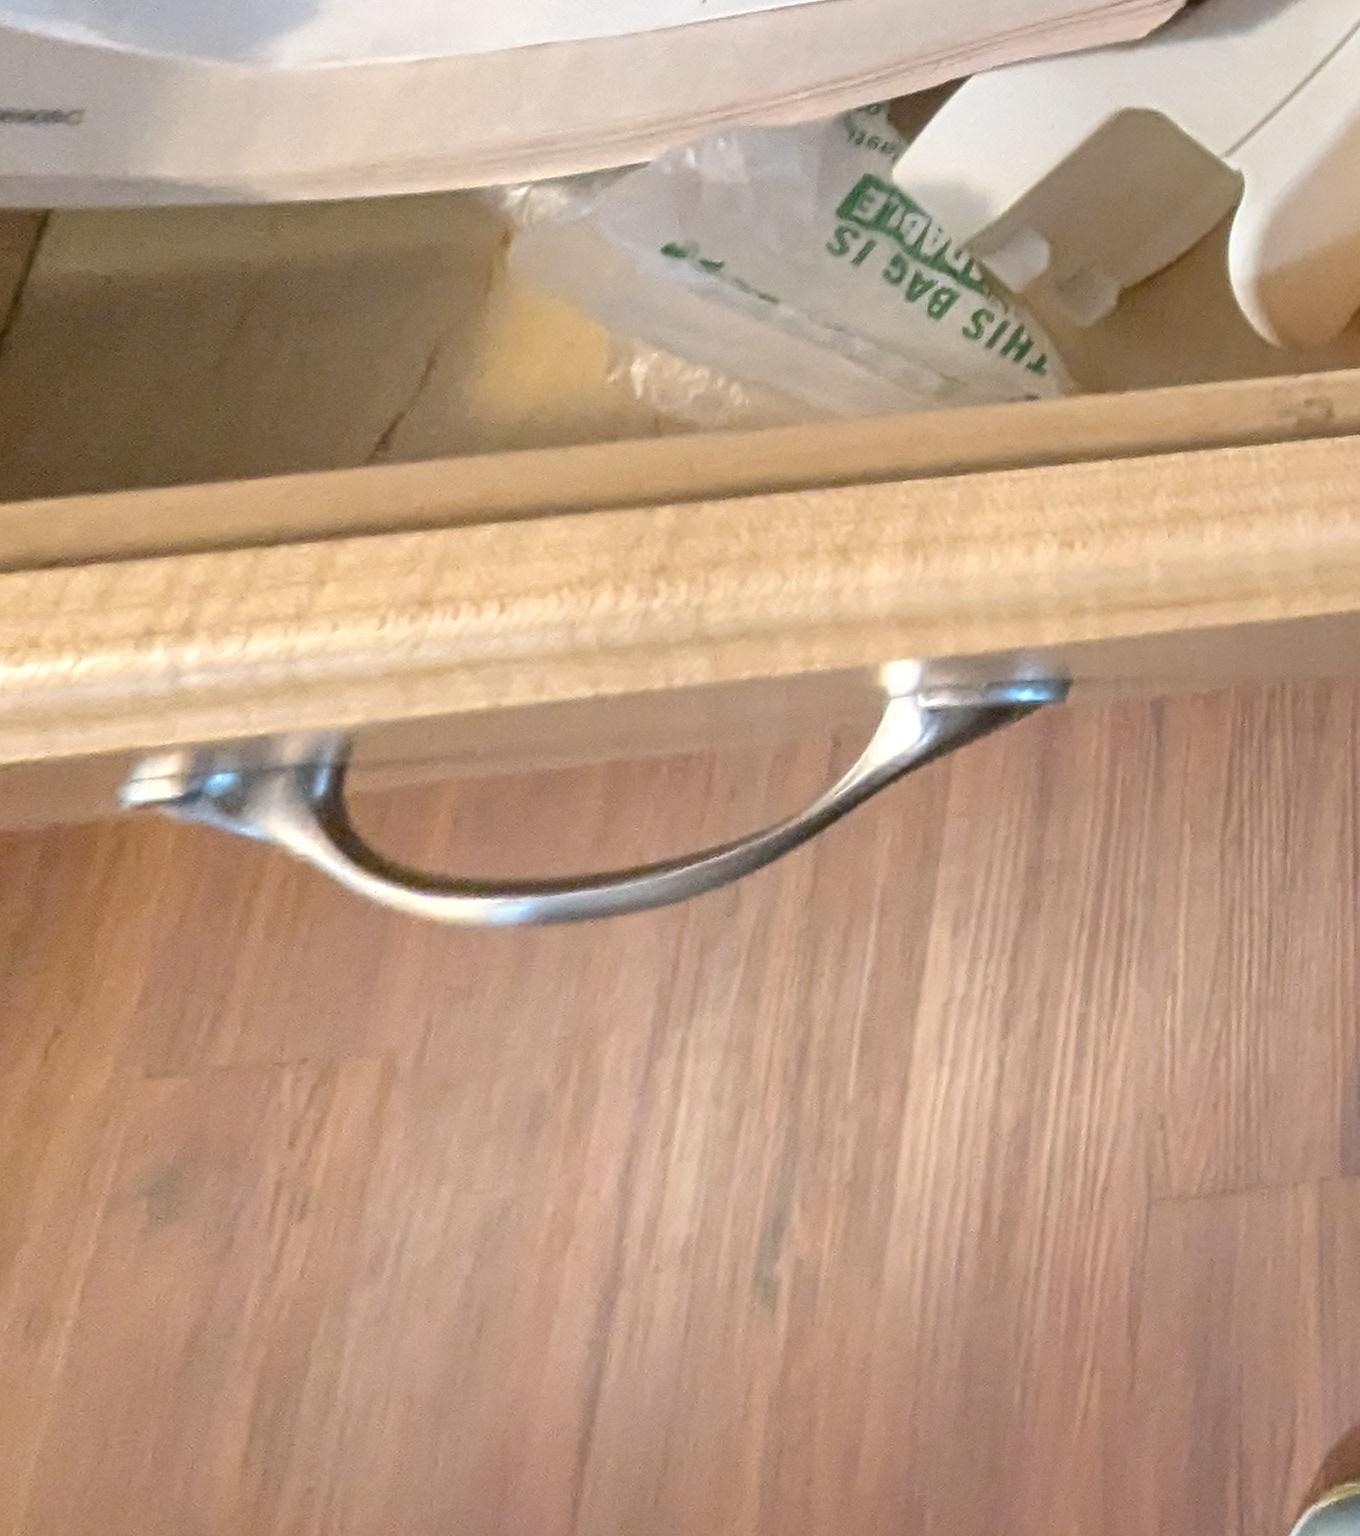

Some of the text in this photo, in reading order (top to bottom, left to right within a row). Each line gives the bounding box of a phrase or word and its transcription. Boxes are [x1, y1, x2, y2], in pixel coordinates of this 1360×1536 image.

[825, 225, 1048, 377] THIS BAG IS
